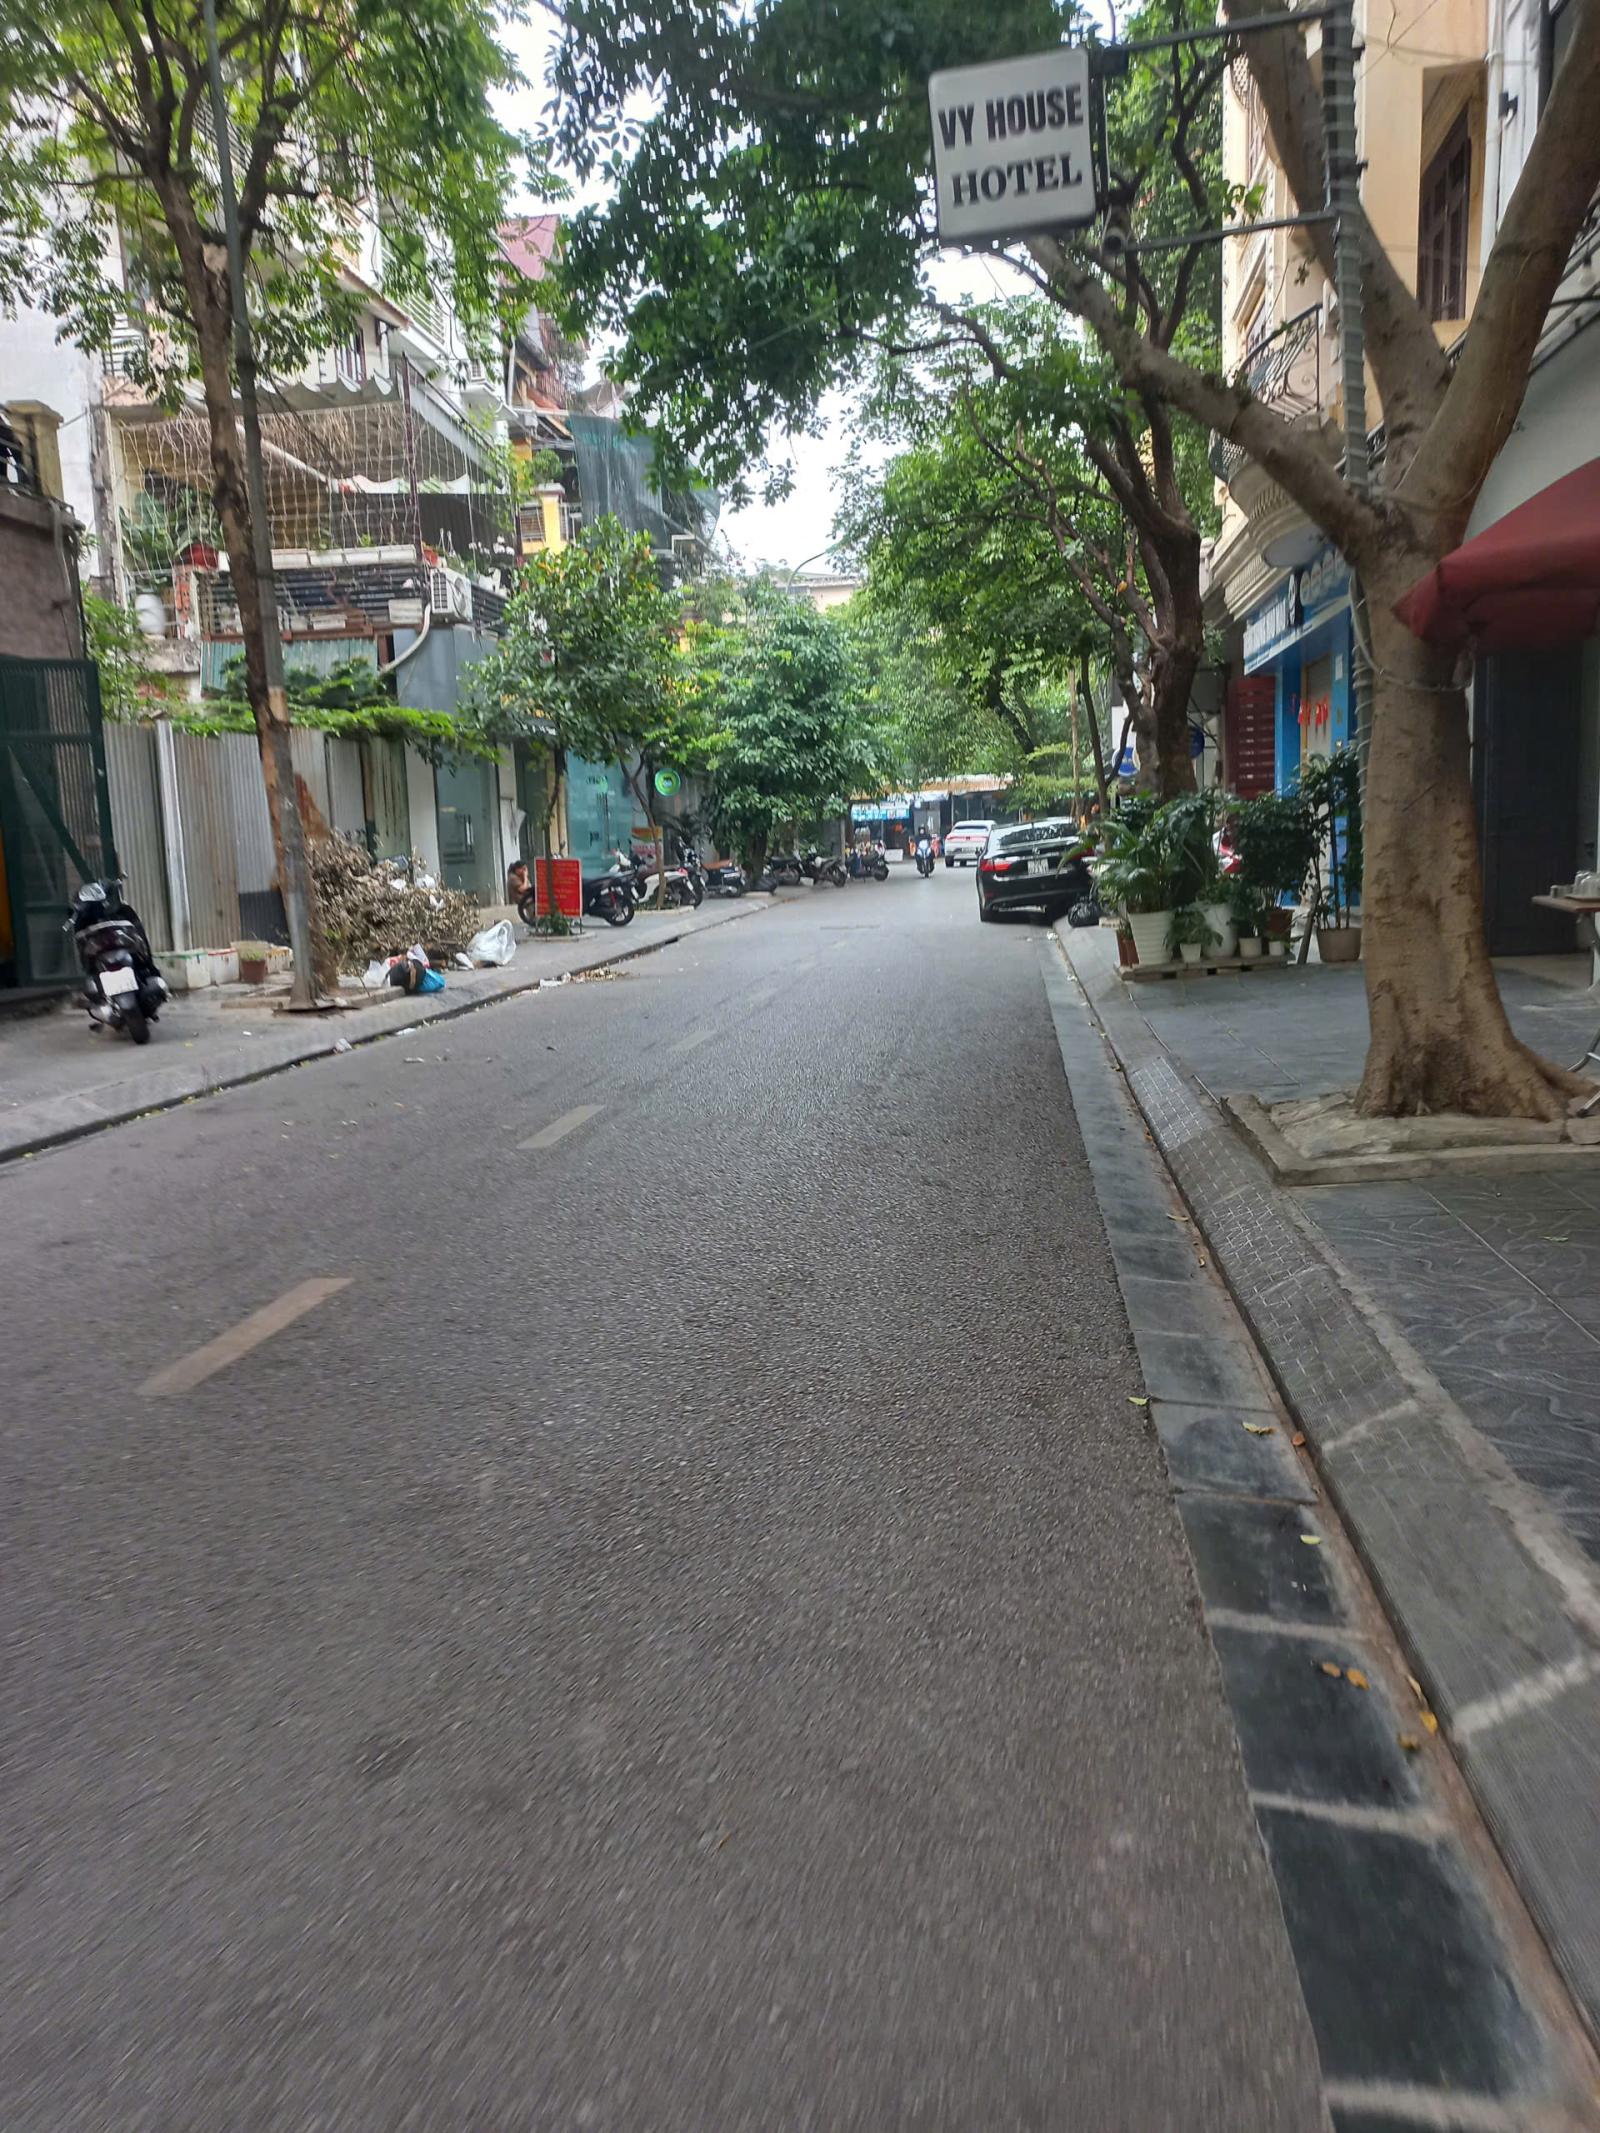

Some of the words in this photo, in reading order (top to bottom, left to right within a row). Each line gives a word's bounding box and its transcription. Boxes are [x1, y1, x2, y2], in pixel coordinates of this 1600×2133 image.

[938, 102, 975, 150] VY
[986, 84, 1083, 142] HOUSE
[952, 152, 1083, 208] HOTEL
